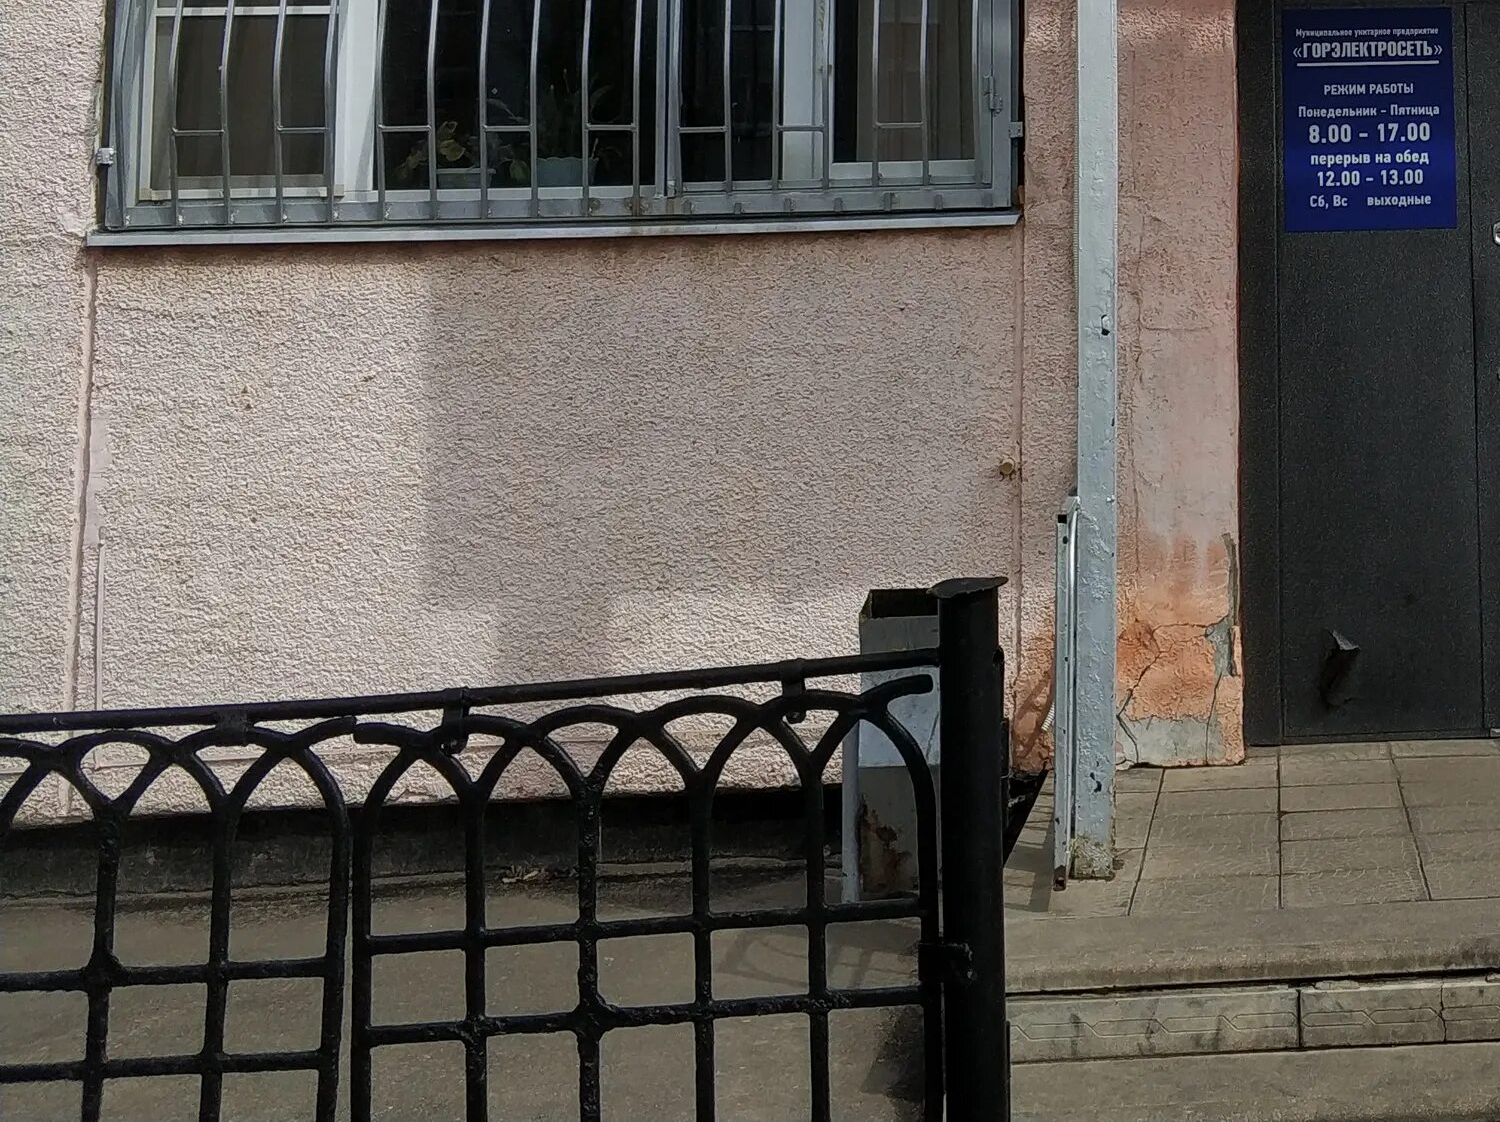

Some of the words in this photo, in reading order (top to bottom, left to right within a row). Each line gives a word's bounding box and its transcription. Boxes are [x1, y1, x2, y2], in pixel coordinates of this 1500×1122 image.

[1295, 28, 1353, 38] Муниципальное
[1354, 29, 1391, 38] унитарное
[1393, 28, 1438, 36] предприятие
[1293, 41, 1442, 58] «ГОРЭЛЕКТРОСЕТЬ»
[1324, 84, 1365, 95] РЕЖИМ
[1370, 83, 1413, 94] РАБОТЫ
[1299, 106, 1376, 118] Понедельник
[1391, 104, 1439, 116] Пятница
[1309, 124, 1351, 143] 8.00
[1378, 123, 1430, 141] 17.00
[1311, 154, 1370, 167] перерыв
[1376, 154, 1391, 163] на
[1396, 150, 1429, 164] обед
[1318, 171, 1360, 186] 12.00
[1381, 169, 1423, 185] 13.00
[1310, 195, 1328, 209] Сб,
[1333, 195, 1347, 206] Вс
[1368, 195, 1432, 208] выходные
